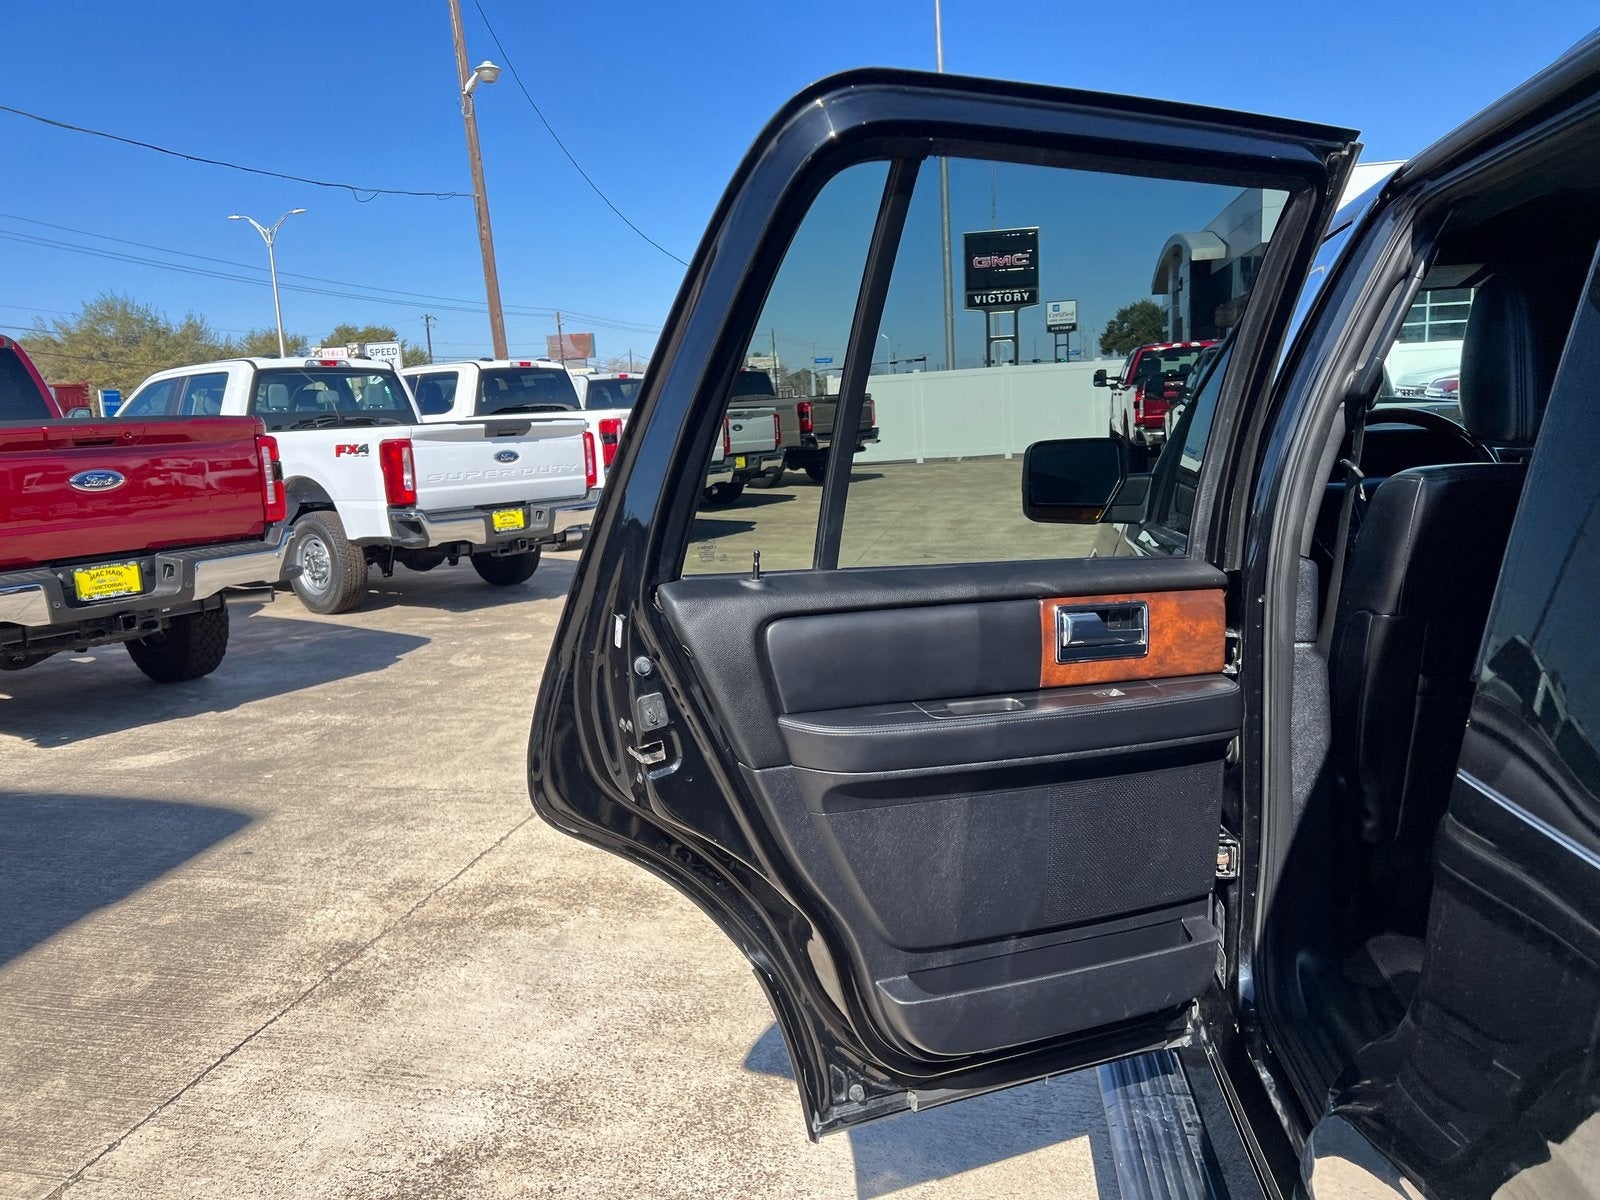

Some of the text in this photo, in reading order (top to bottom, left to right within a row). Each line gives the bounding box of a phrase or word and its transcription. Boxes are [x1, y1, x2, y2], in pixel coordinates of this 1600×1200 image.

[972, 253, 1030, 269] GMC
[974, 292, 1030, 304] VICTORY
[369, 347, 398, 357] SPEED
[335, 443, 370, 458] FX4
[426, 463, 579, 484] SUPER DUTY
[84, 474, 113, 487] Ford
[90, 569, 124, 581] MAC HAIK
